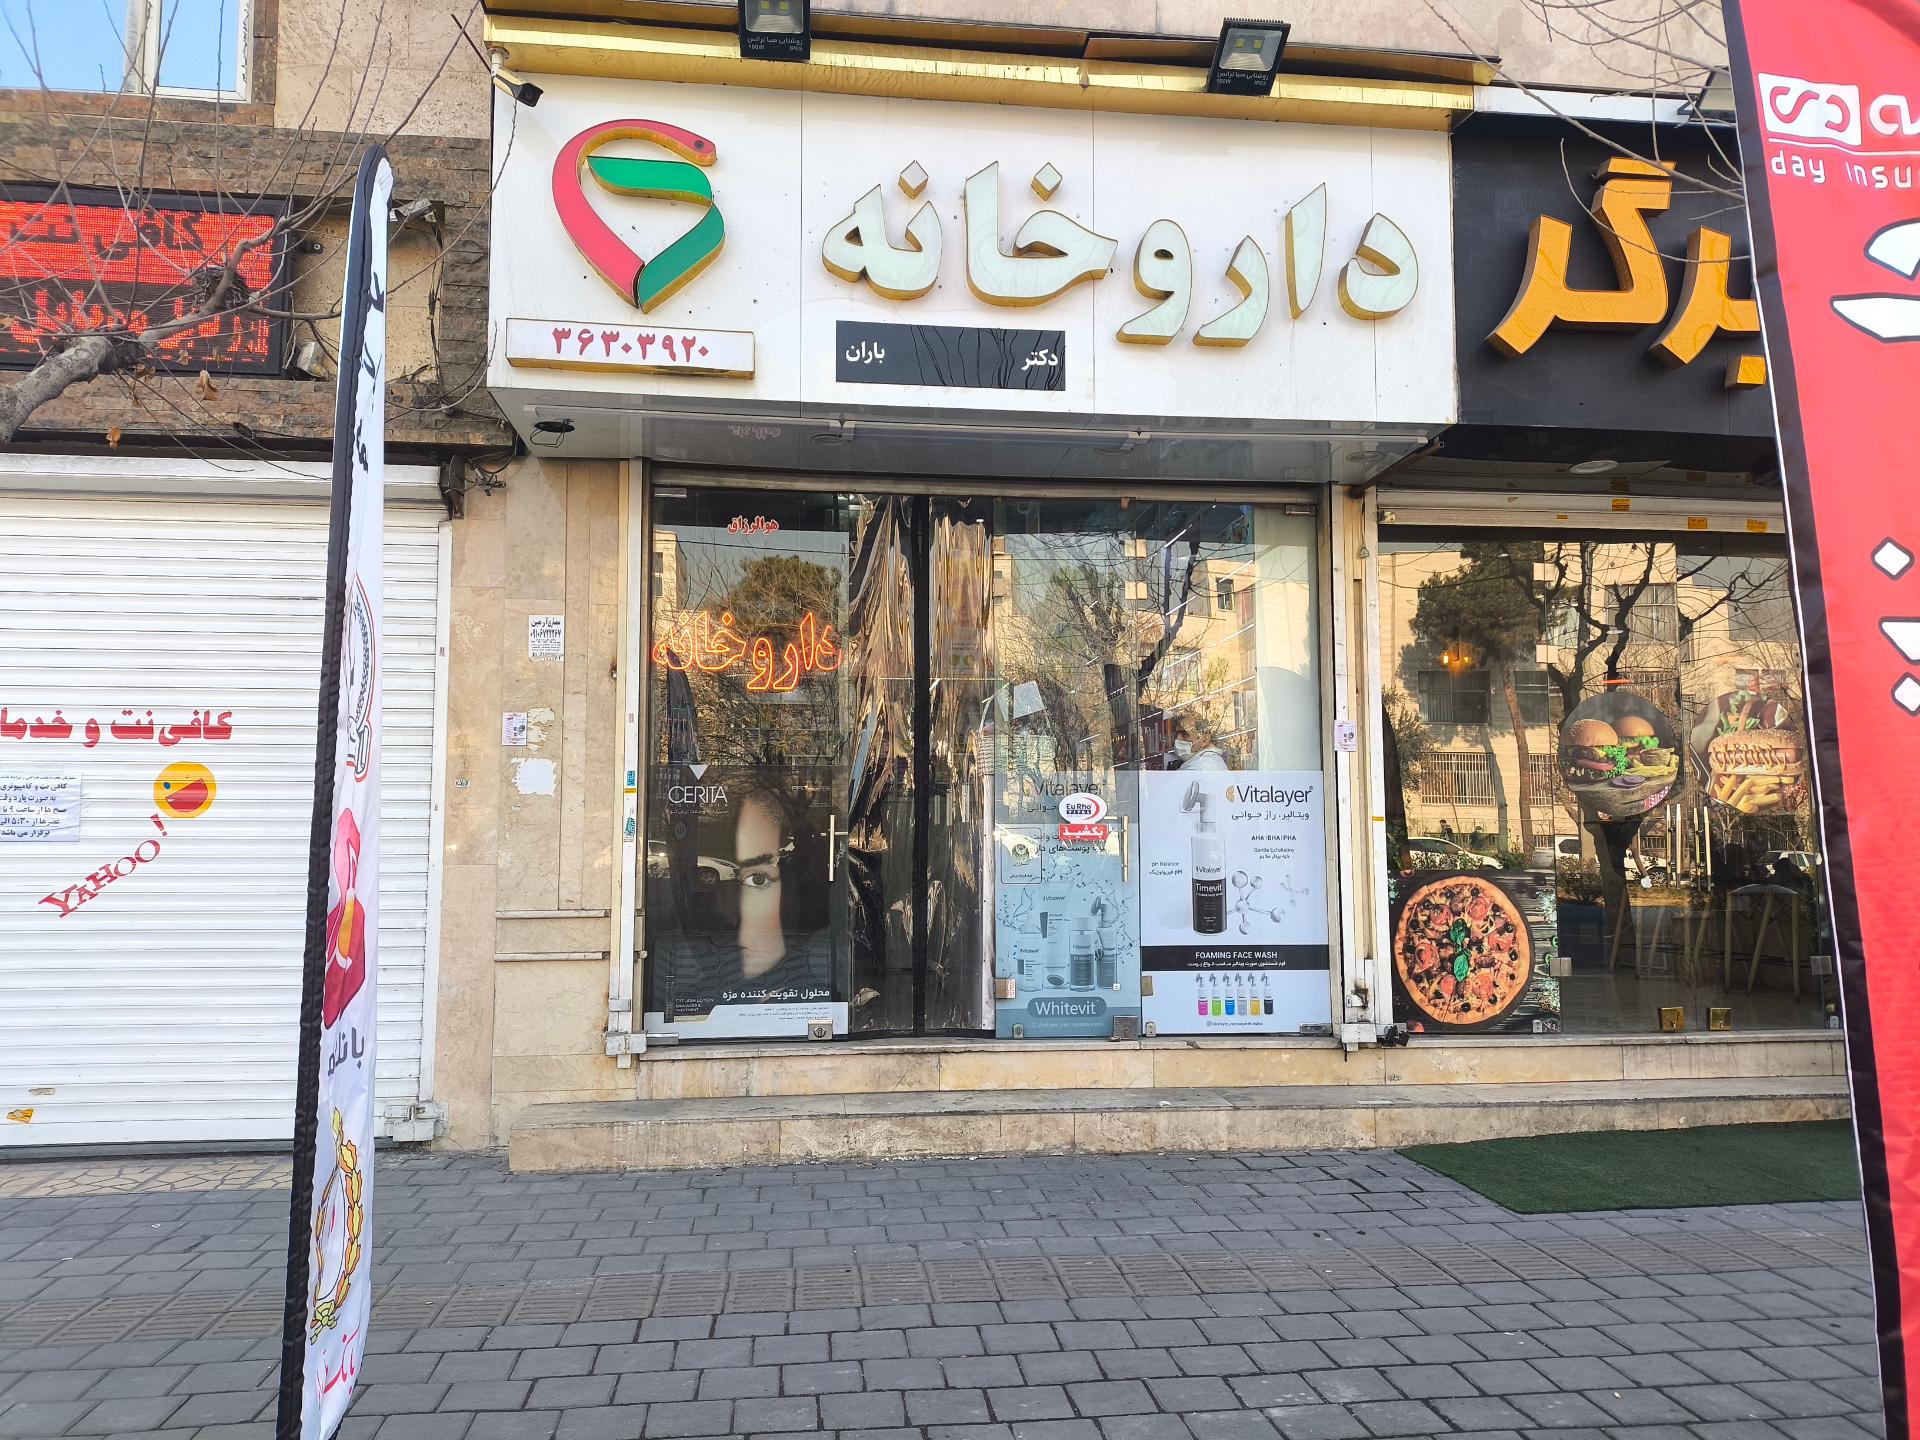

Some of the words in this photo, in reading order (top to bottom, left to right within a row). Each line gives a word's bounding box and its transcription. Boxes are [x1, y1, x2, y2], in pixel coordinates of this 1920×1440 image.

[1770, 149, 1826, 184] day
[552, 327, 709, 362] ۳۶۳۰۳۹۲۰
[846, 341, 886, 364] باران
[1021, 349, 1059, 370] دکتر
[83, 718, 101, 748] و
[111, 709, 154, 739] نت
[159, 709, 233, 746] کافی
[50, 783, 67, 791] کافی
[668, 785, 729, 803] CERITA
[1237, 785, 1313, 807] Vitalayer
[1231, 811, 1262, 821] جوانی
[1265, 811, 1277, 820] راز
[722, 989, 738, 1001] مژه
[740, 989, 768, 999] کننده
[770, 988, 799, 999] تقویت
[800, 988, 830, 999] محلول
[1035, 1000, 1096, 1016] Whitevit
